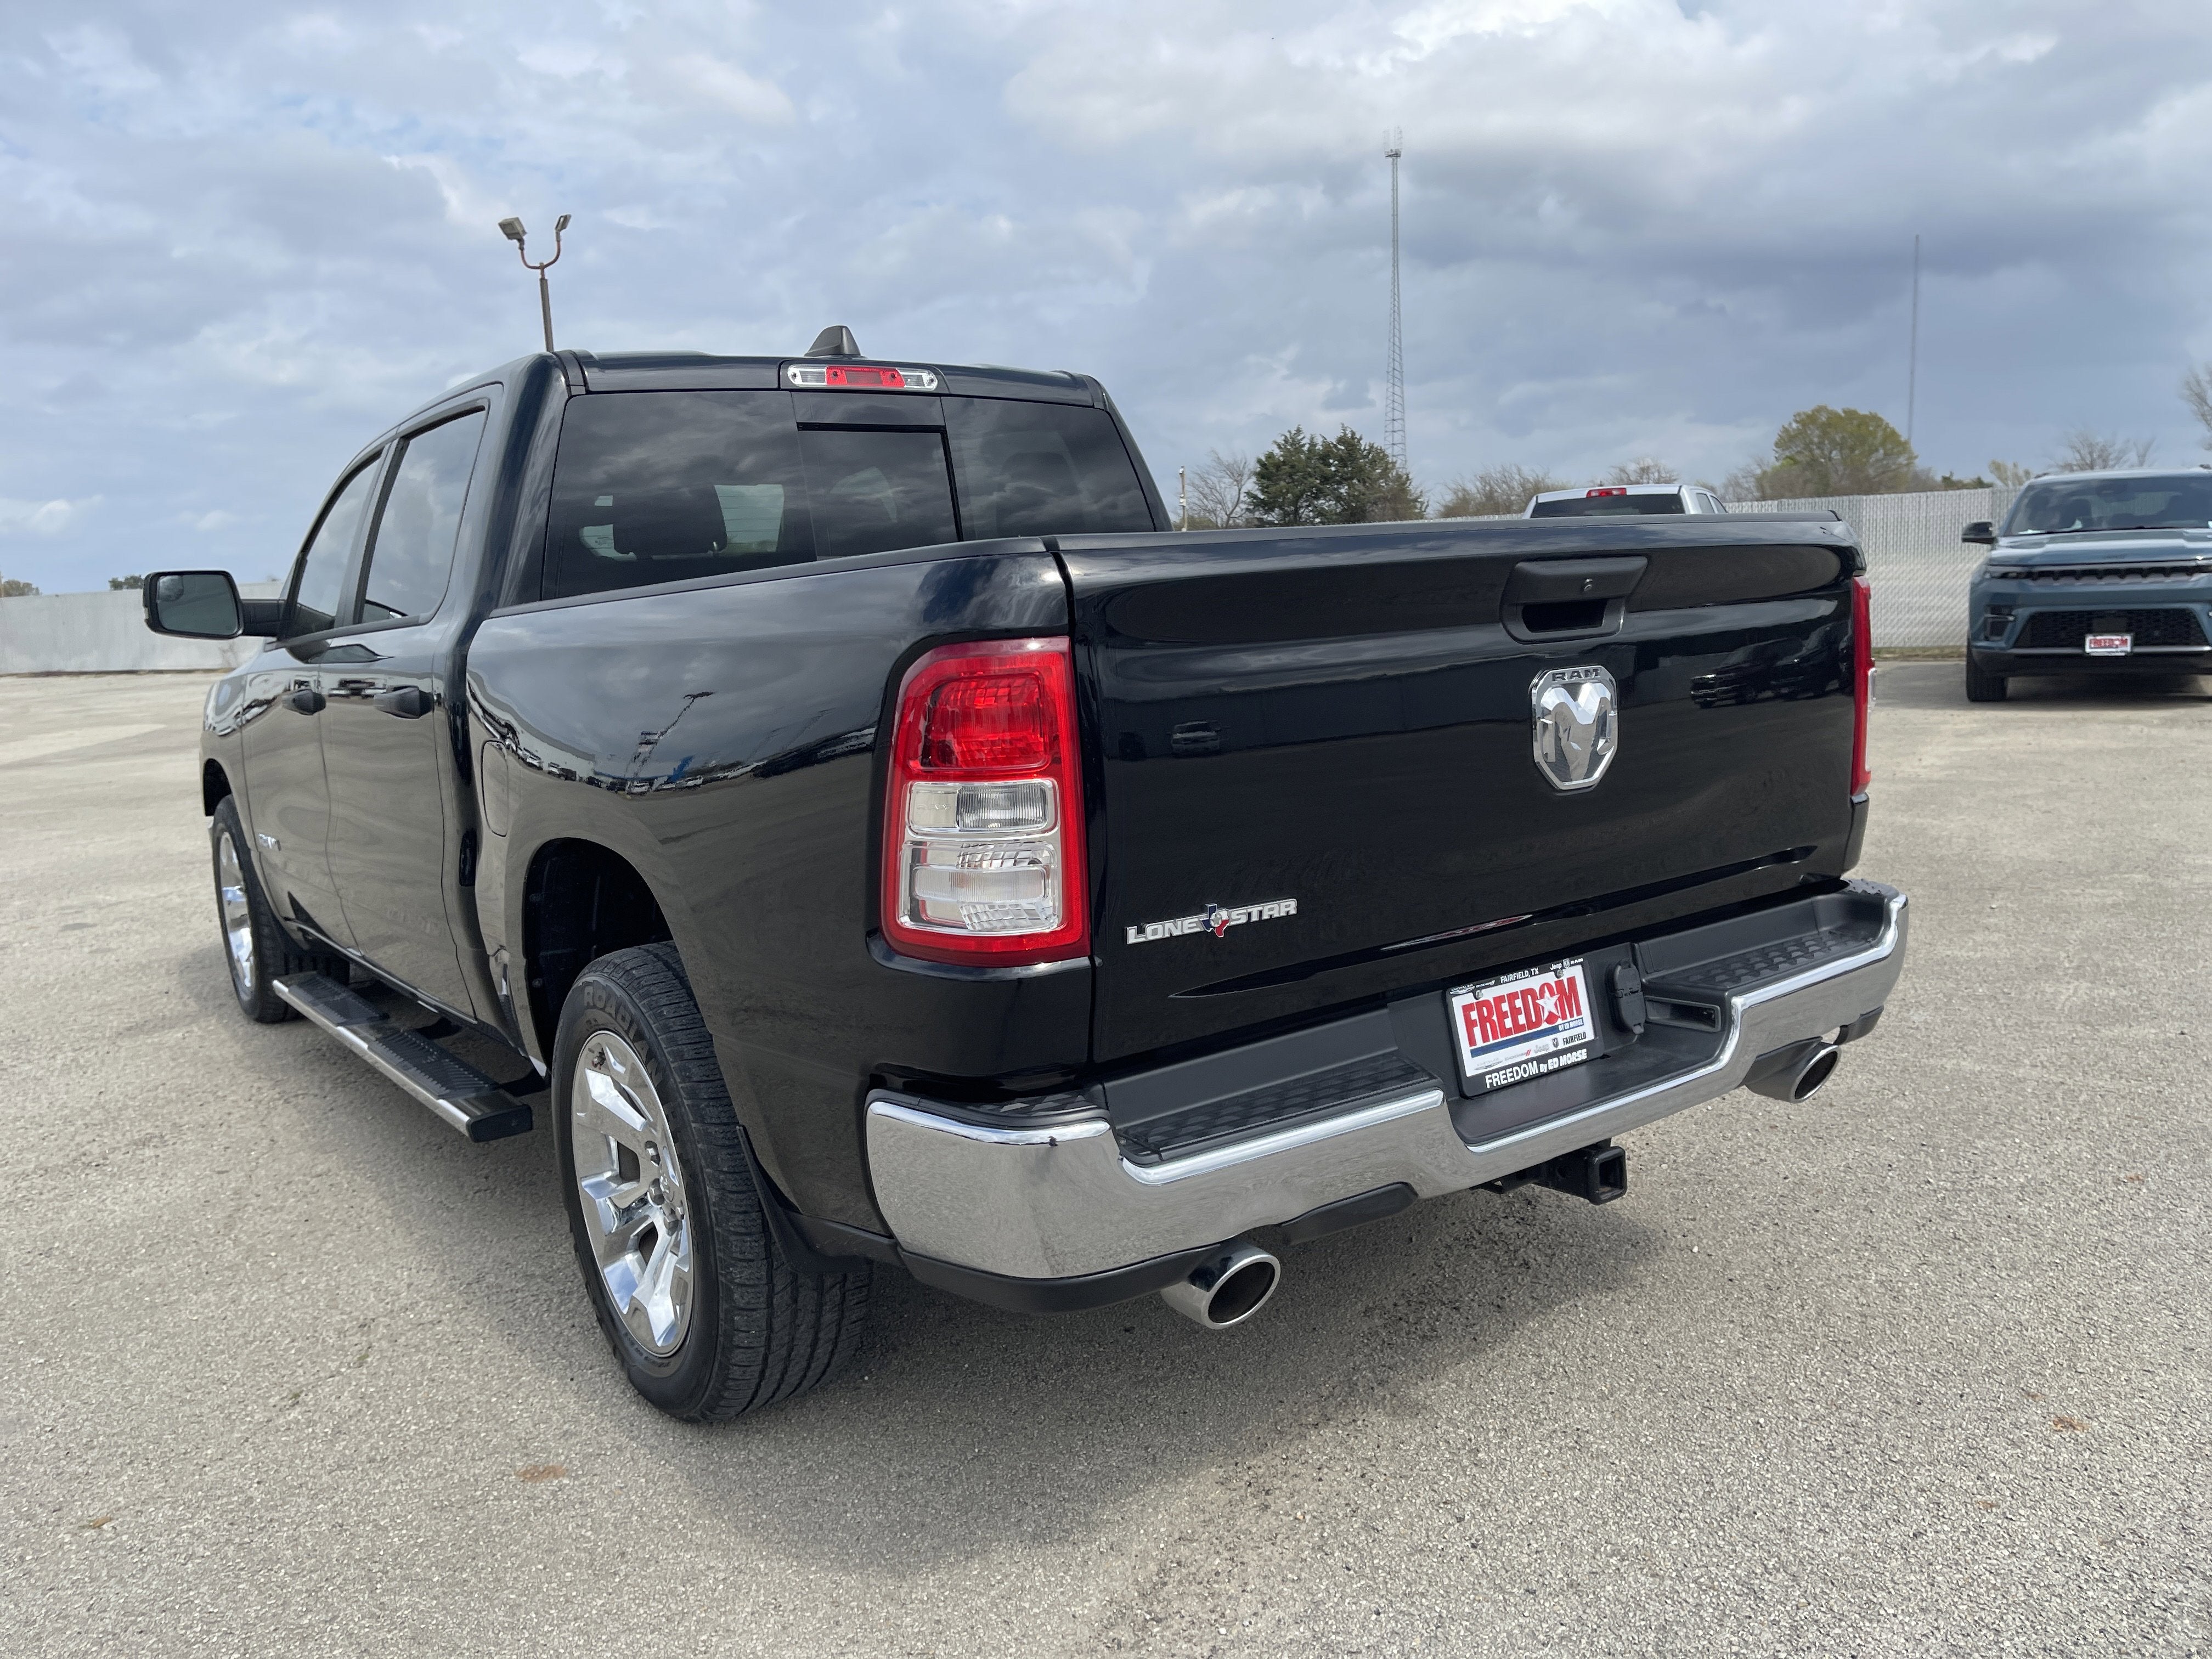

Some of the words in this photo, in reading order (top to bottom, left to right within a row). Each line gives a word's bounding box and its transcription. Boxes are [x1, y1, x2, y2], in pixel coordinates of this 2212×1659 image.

[1551, 668, 1600, 682] RAM
[1126, 917, 1201, 945] LONE
[1229, 899, 1297, 926] STAR
[1500, 970, 1531, 984] FAIRFIELD,
[1530, 967, 1539, 977] TX
[1462, 975, 1583, 1048] FREEDOM
[1562, 1031, 1587, 1045] FAIRFIELD
[1485, 1060, 1539, 1089] FREEDOM
[1548, 1057, 1559, 1070] ED
[1559, 1048, 1588, 1066] MORSE
